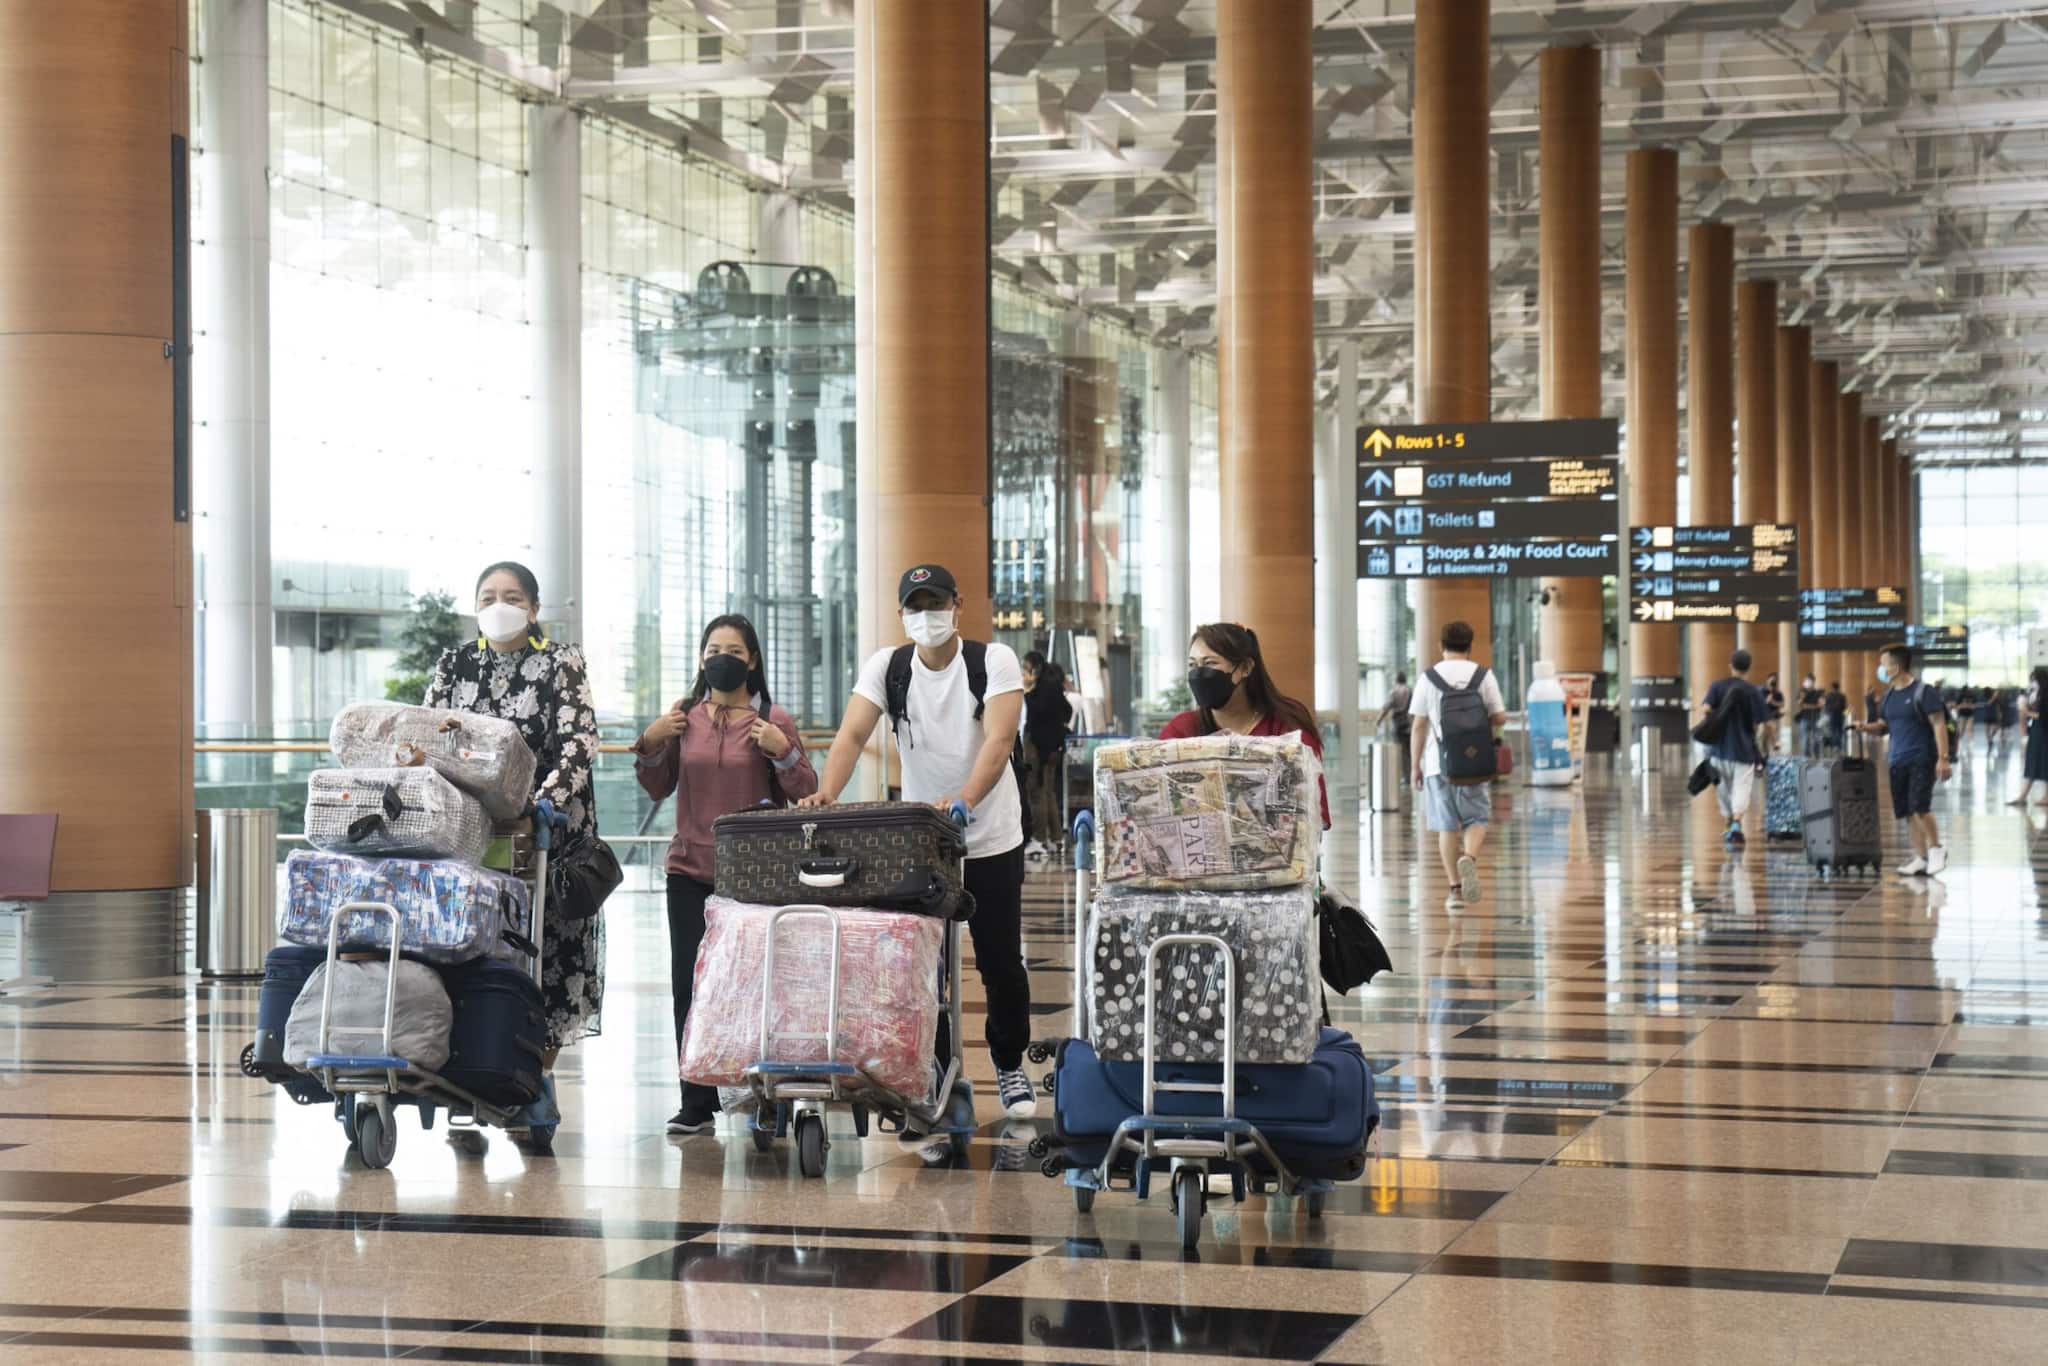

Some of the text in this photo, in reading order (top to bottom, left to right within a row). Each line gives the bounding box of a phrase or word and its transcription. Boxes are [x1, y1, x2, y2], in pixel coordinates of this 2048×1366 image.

[1395, 434, 1433, 449] Rows
[1436, 432, 1443, 448] 1
[1454, 432, 1465, 448] 5
[1427, 471, 1511, 488] GST Refund
[1427, 513, 1474, 527] Toilets
[1695, 530, 1730, 541] Refund
[1427, 543, 1608, 562] Shops & 24hr Food Court
[1674, 556, 1707, 568] Money
[1709, 555, 1749, 568] Changer
[1427, 563, 1442, 575] (at
[1444, 562, 1495, 574] Basement
[1674, 604, 1732, 616] Information
